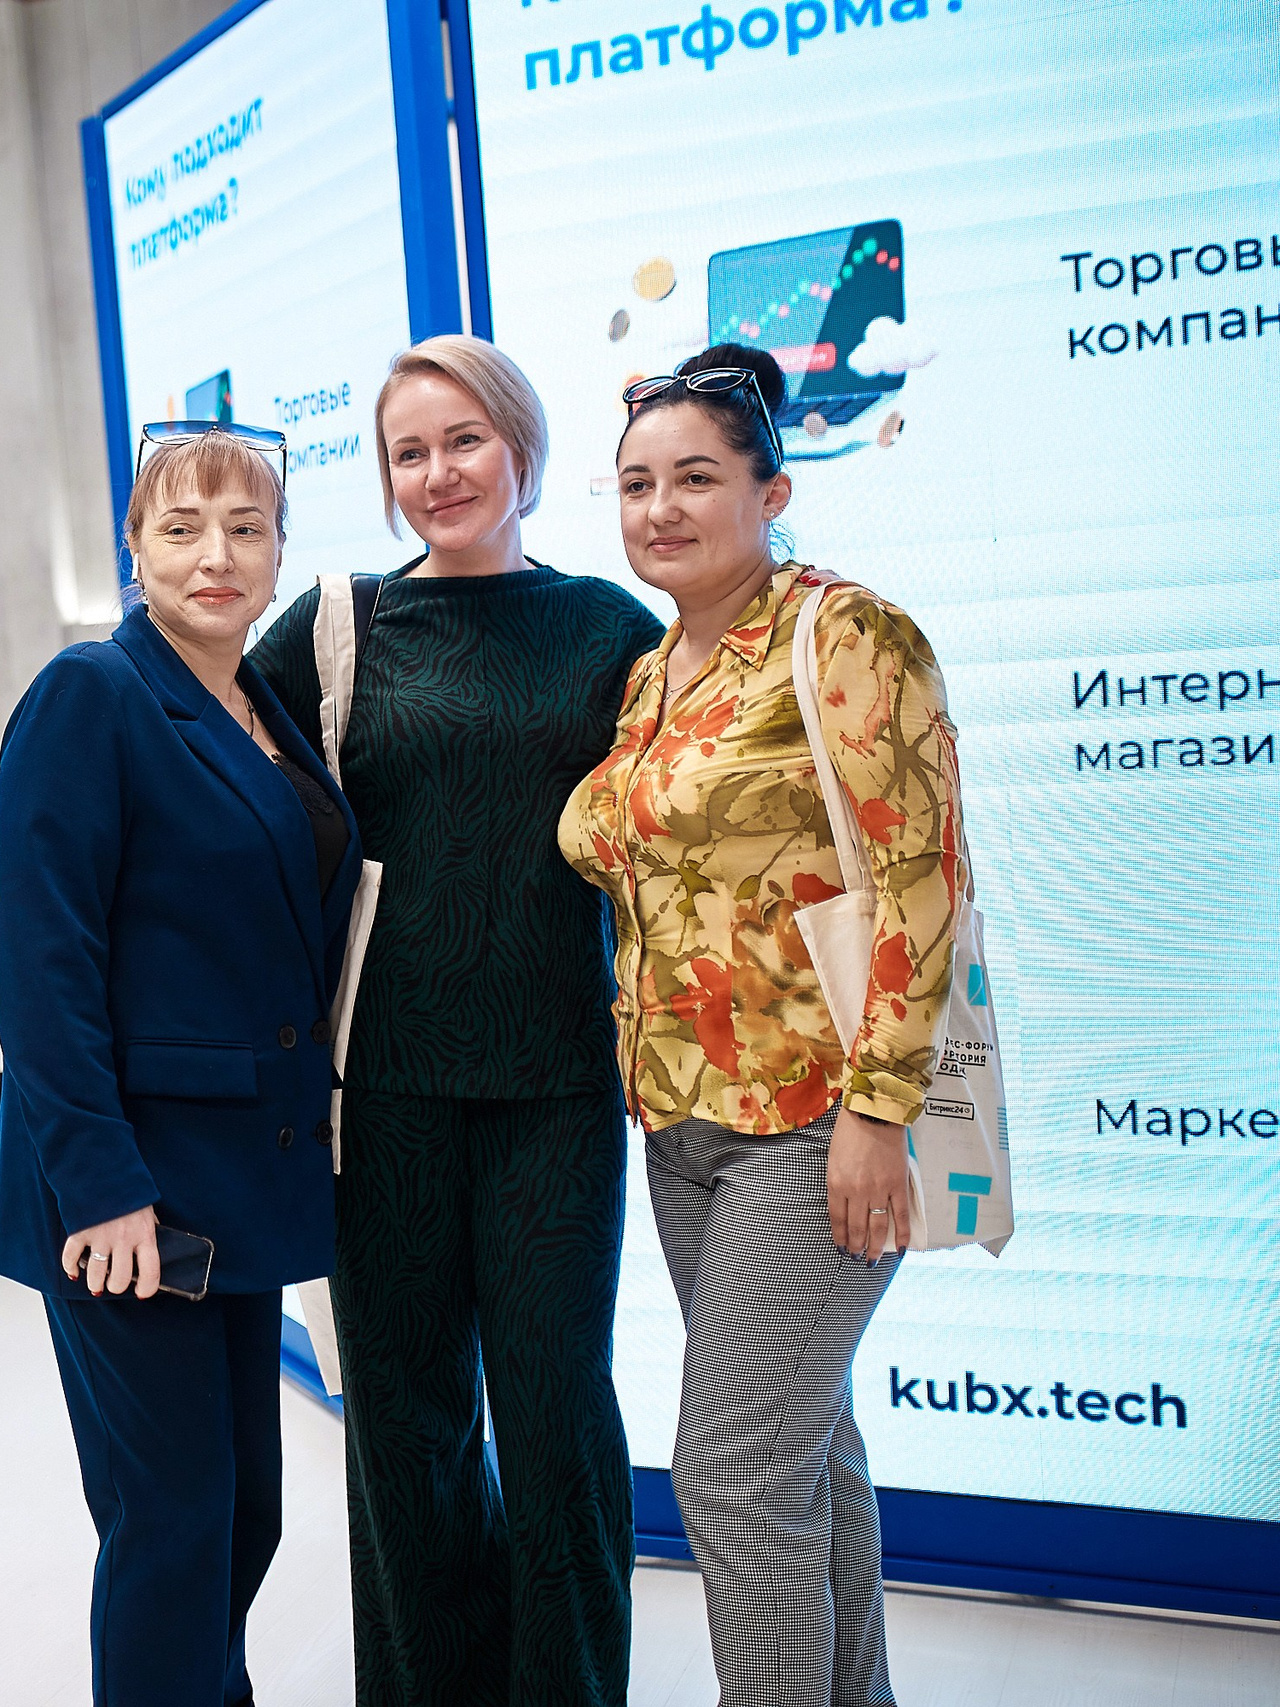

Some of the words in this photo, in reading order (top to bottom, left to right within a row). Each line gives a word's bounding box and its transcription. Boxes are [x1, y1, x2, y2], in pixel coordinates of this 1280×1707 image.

[524, 0, 963, 91] платформа
[126, 165, 167, 210] Кому
[173, 96, 262, 182] подходит
[131, 177, 239, 270] платформа?
[274, 382, 351, 429] Торговые
[279, 432, 361, 473] омпании
[1074, 669, 1280, 712] Интерн
[1076, 733, 1274, 772] магази
[1096, 1098, 1280, 1147] Марке
[889, 1366, 1188, 1429] kubx.tech
